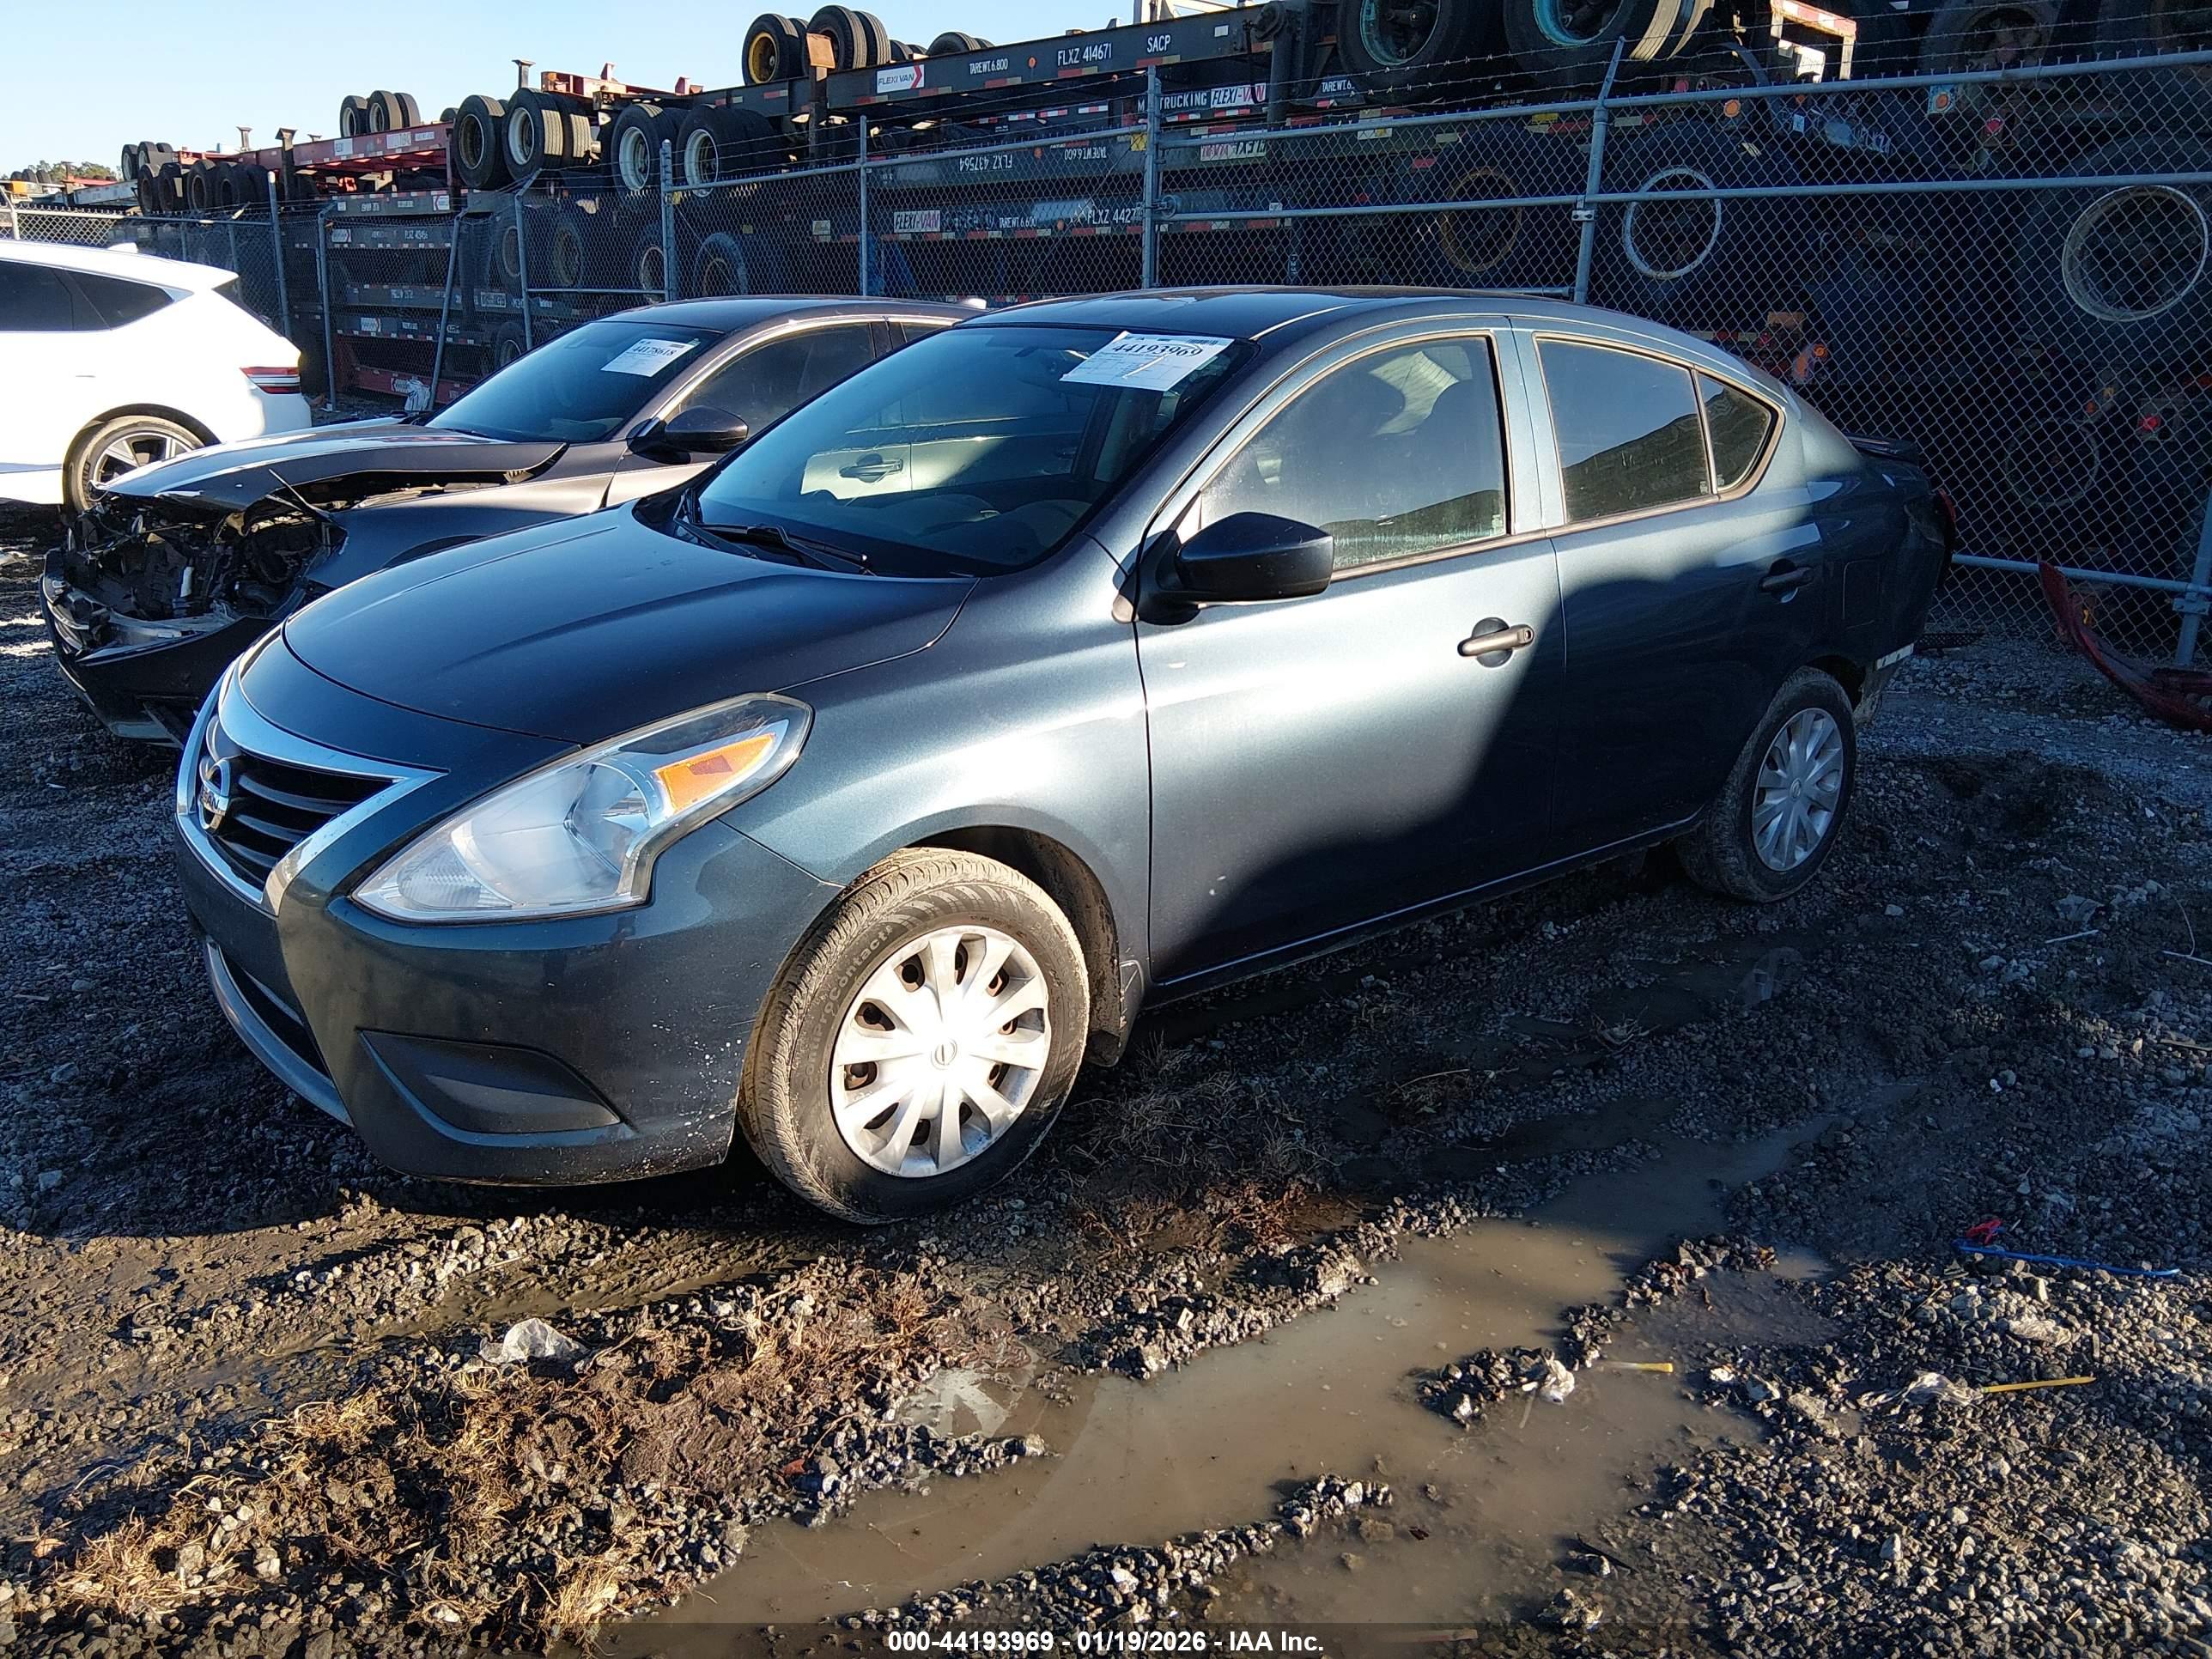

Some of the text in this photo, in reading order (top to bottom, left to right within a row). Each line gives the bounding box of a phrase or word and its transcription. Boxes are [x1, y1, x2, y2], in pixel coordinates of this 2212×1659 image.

[1146, 34, 1170, 53] SACP
[1057, 42, 1112, 66] FLXZ 414671
[1159, 92, 1207, 110] TRUCKING
[1112, 208, 1139, 224] 4427
[1112, 343, 1203, 357] 44193969
